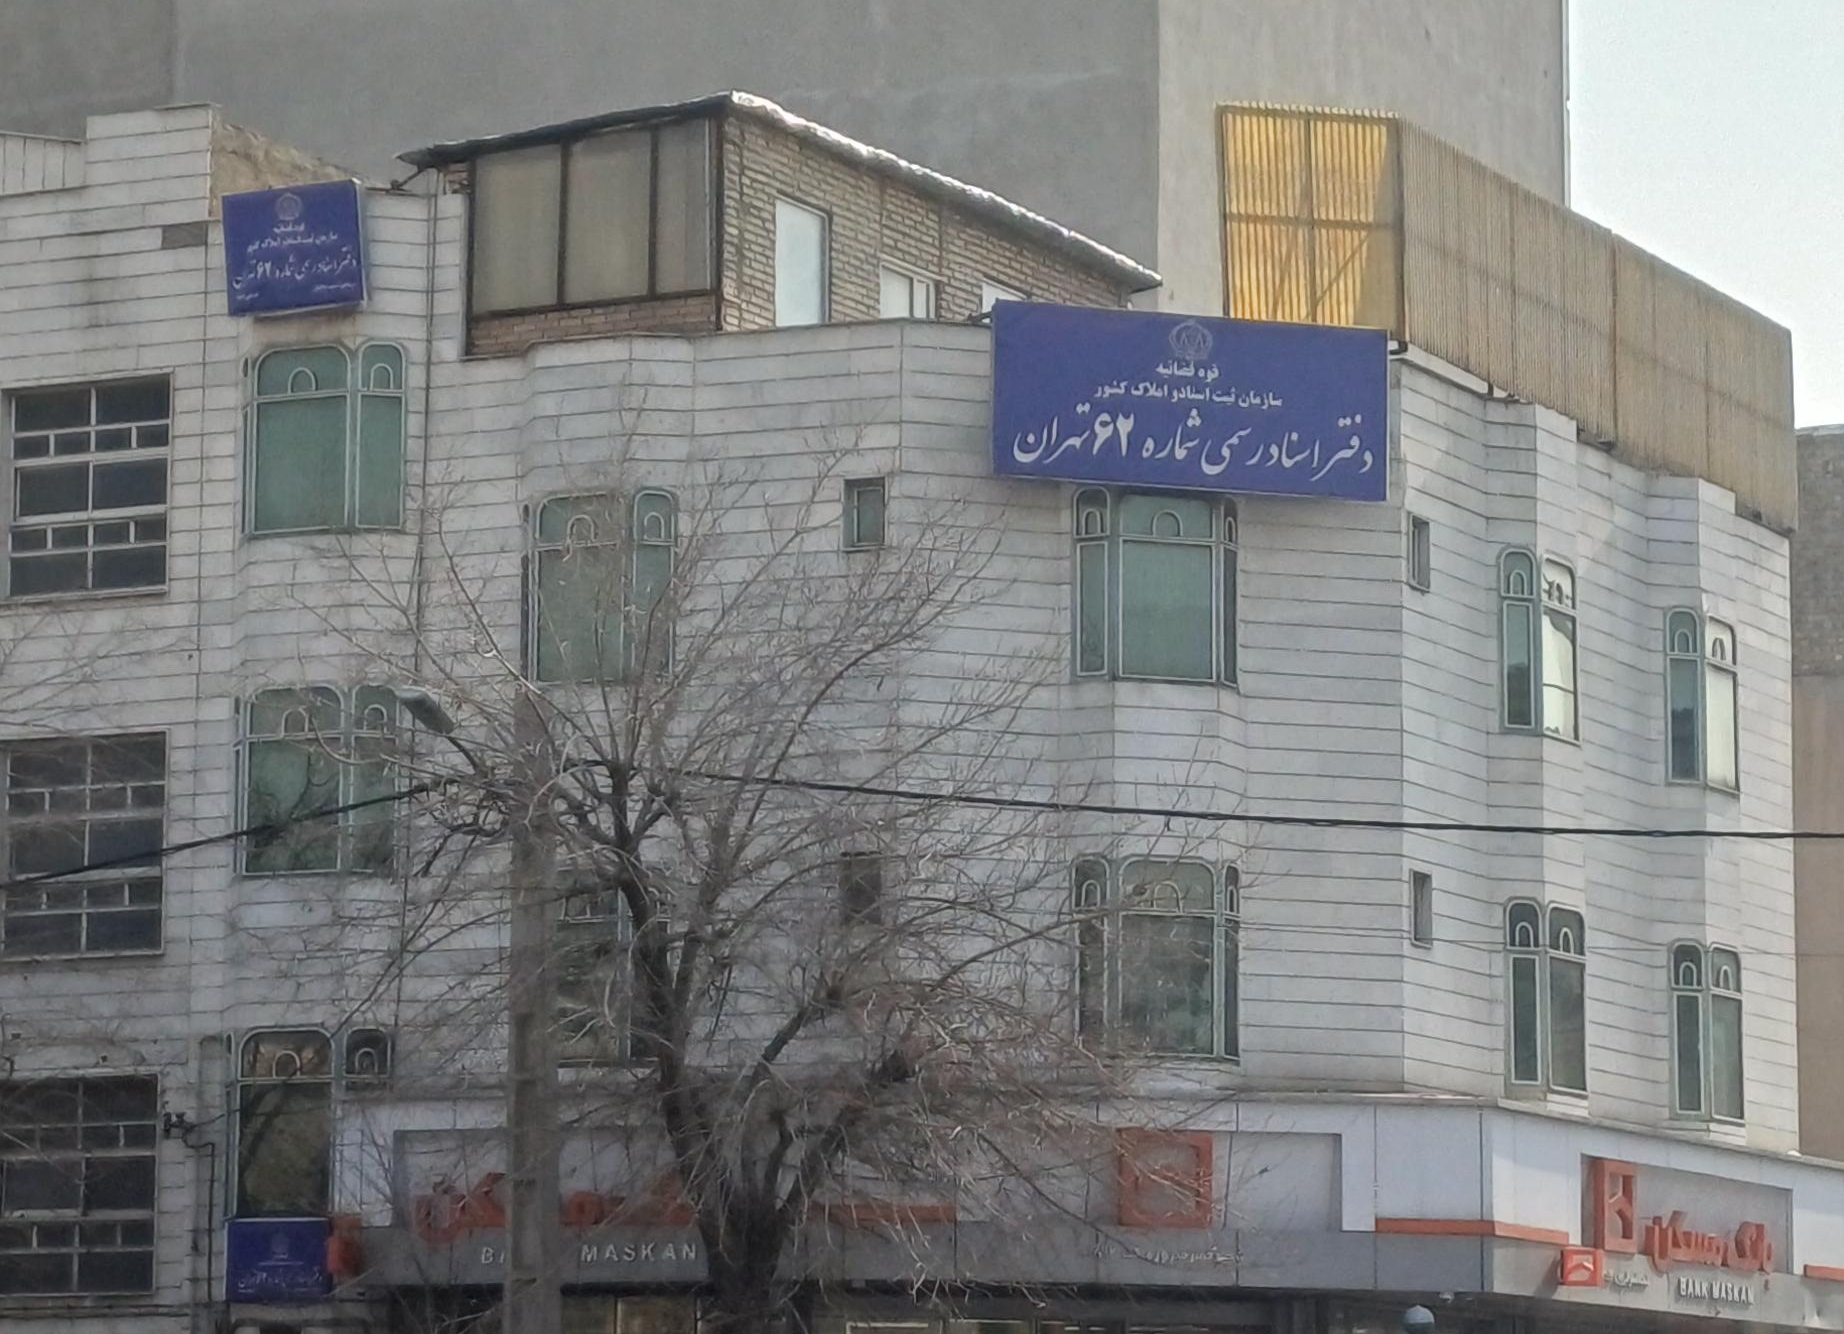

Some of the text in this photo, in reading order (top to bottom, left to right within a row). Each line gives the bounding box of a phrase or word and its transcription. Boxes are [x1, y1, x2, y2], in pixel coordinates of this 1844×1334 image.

[1197, 363, 1220, 383] قوه
[1093, 379, 1129, 398] کشور
[1130, 381, 1168, 398] املاک
[1211, 386, 1236, 405] ثبت
[1237, 390, 1284, 410] سازمان
[1012, 401, 1374, 482] دفتر اسناد رسمی شماره ۶۲ تهران
[580, 1242, 698, 1263] MASKAN
[1644, 1209, 1775, 1291] بانک مسکن
[1679, 1275, 1709, 1298] BANK
[1712, 1280, 1756, 1306] MASKAN
